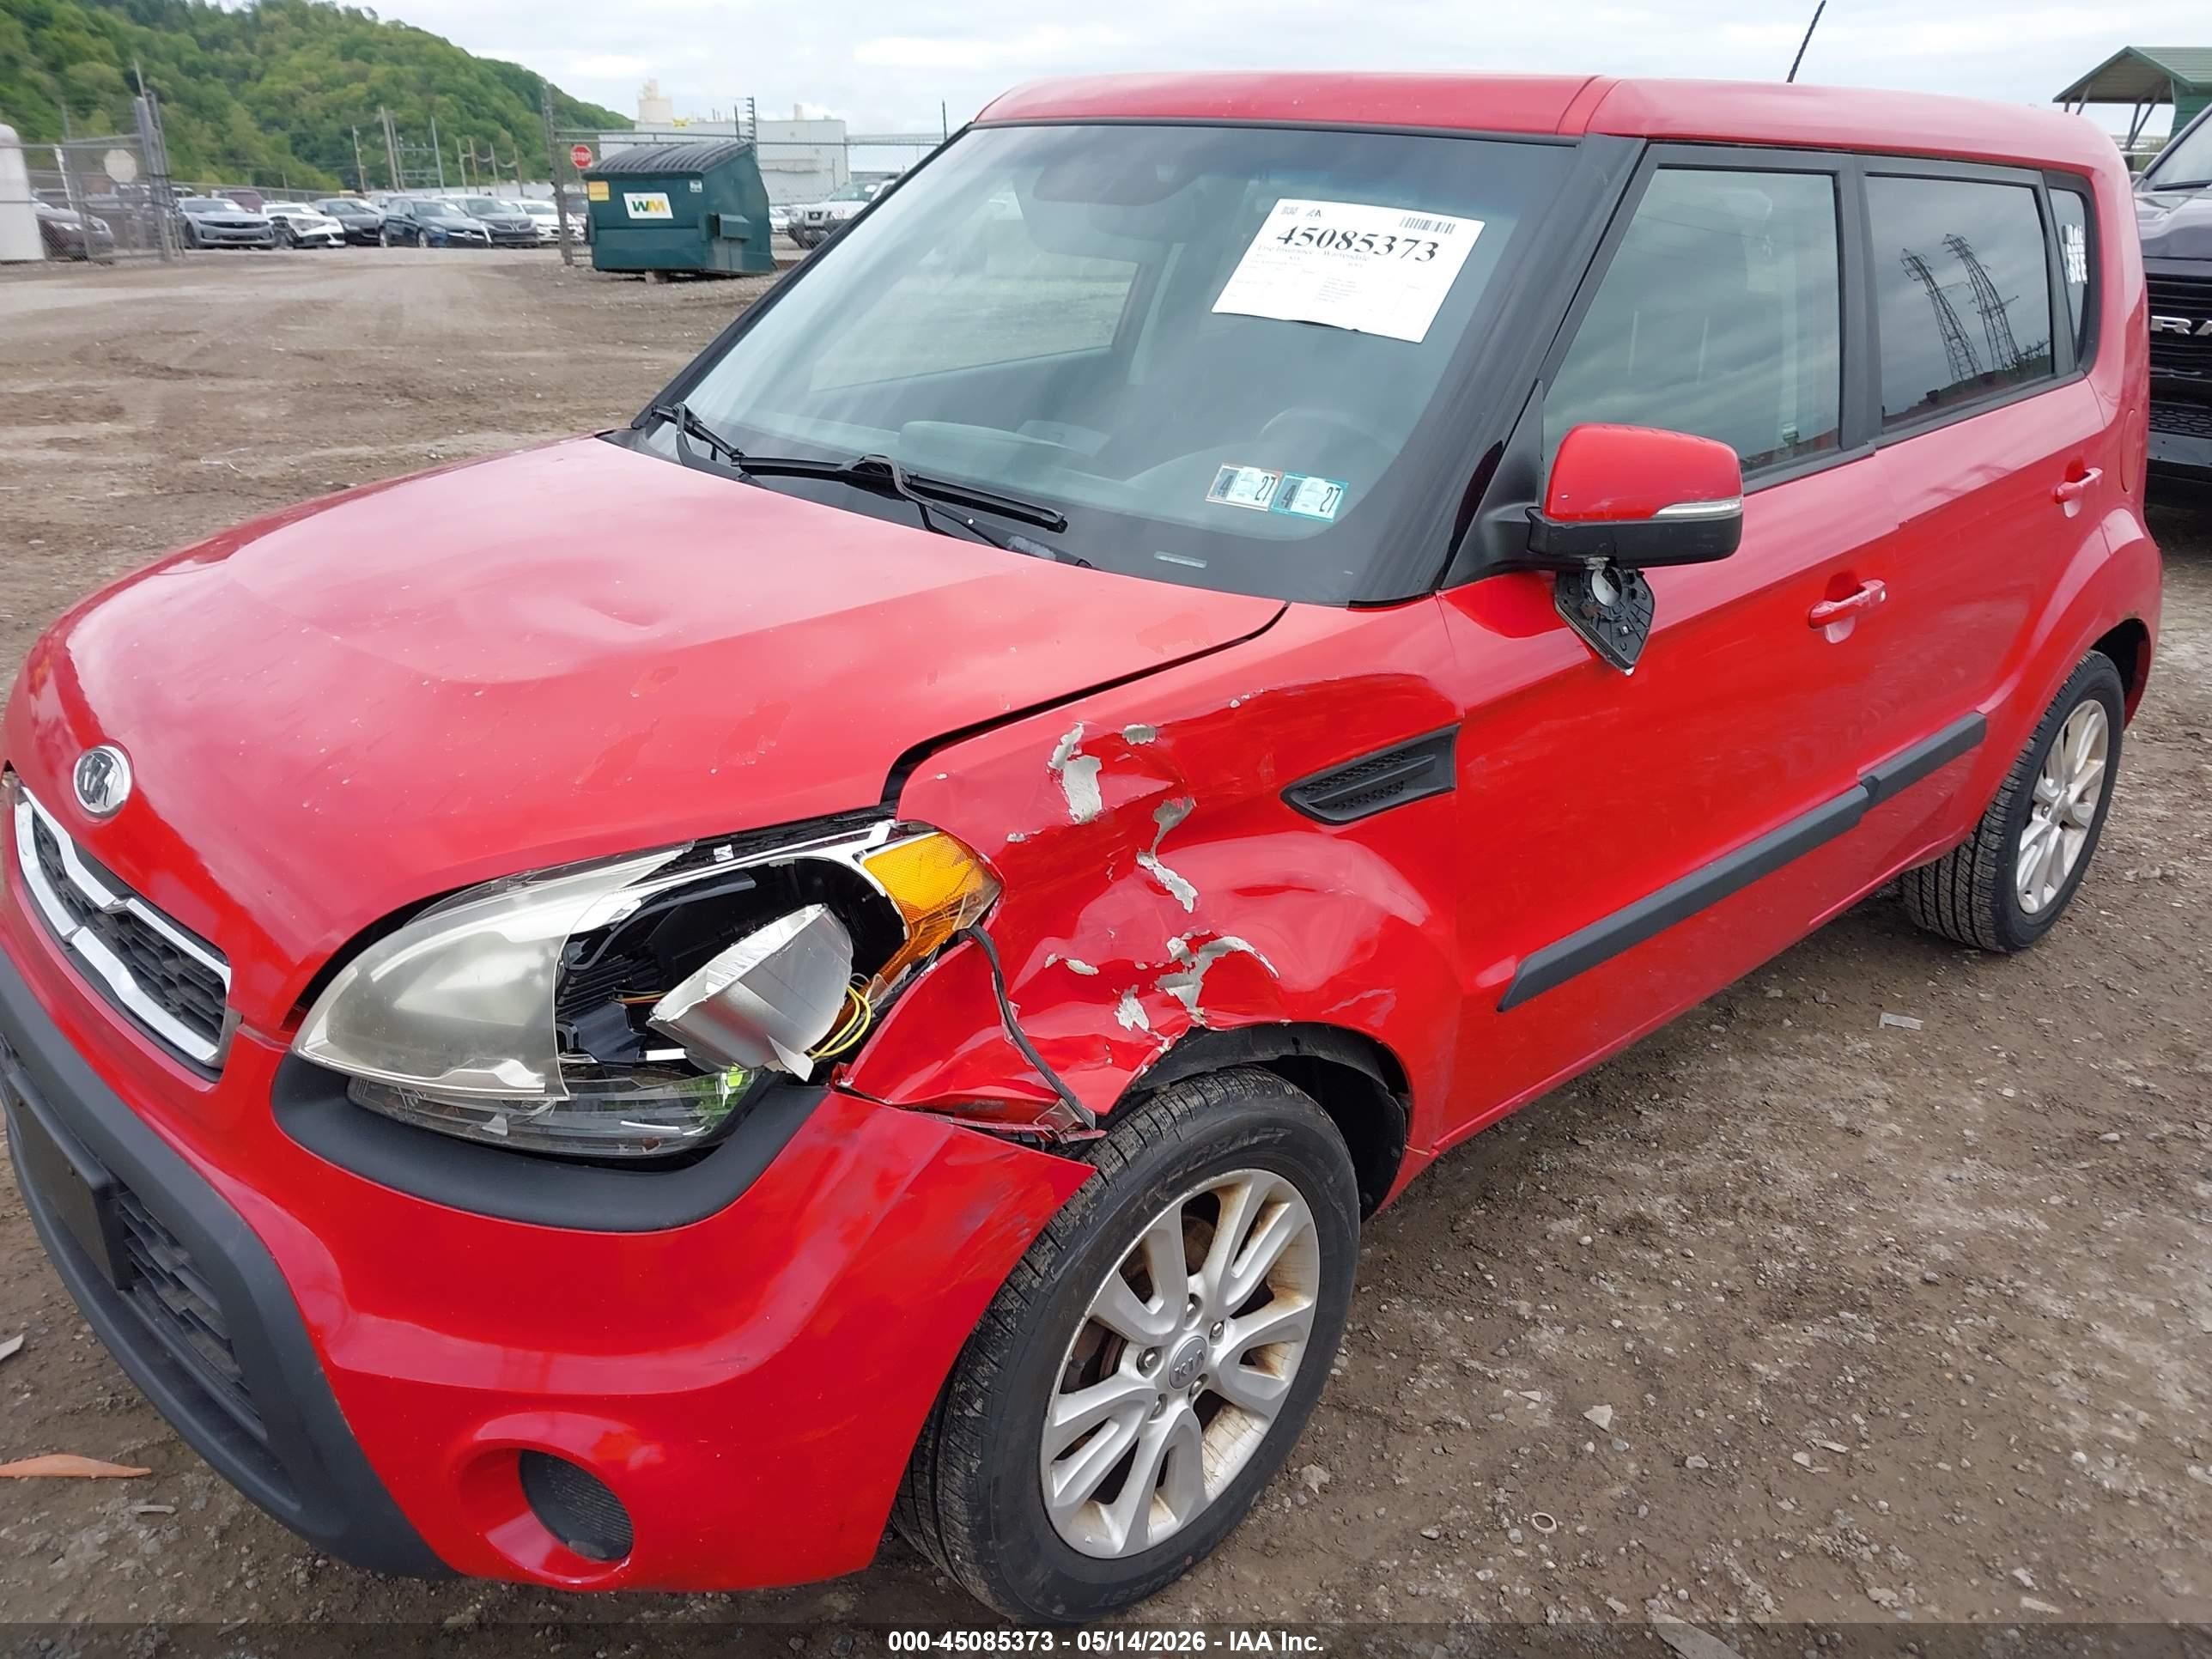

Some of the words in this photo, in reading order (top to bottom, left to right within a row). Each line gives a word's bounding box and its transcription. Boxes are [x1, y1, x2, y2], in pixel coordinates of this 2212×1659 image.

[572, 151, 591, 161] STOP
[631, 199, 666, 212] WM
[1276, 225, 1440, 263] 45085373
[1255, 476, 1277, 502] 27
[1281, 484, 1297, 508] 4
[1319, 486, 1341, 514] 27
[1174, 1349, 1205, 1382] KIA
